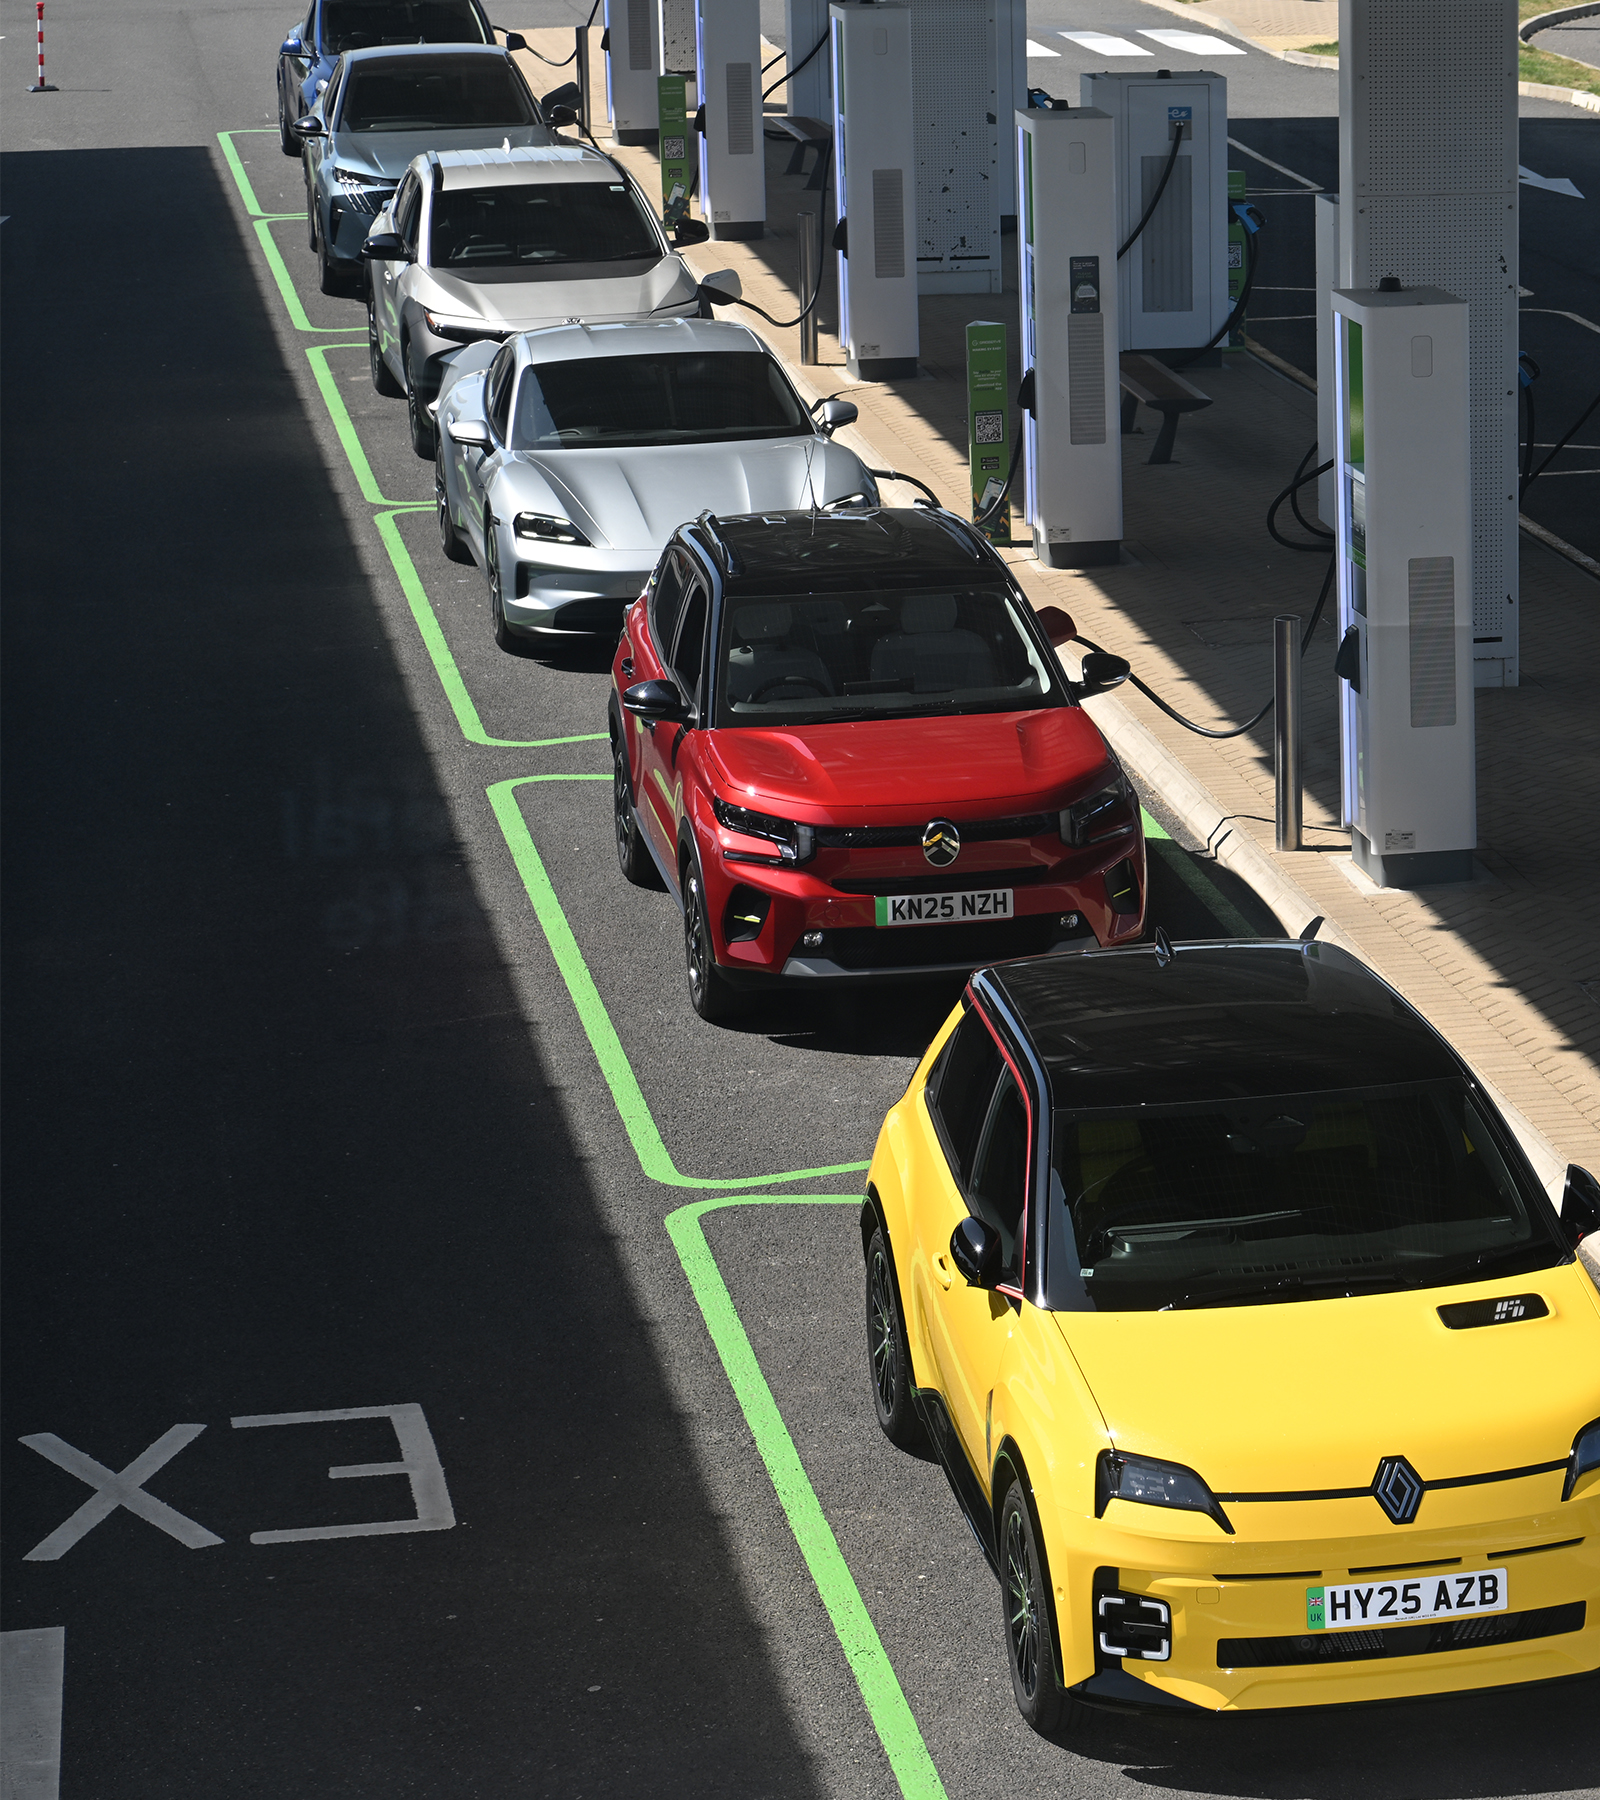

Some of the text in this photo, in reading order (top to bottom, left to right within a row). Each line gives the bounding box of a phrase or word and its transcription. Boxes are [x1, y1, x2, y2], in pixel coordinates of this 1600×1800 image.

[891, 892, 1008, 921] KN25 NZH
[1330, 1574, 1499, 1621] HY25 AZB
[1310, 1612, 1323, 1622] UK
